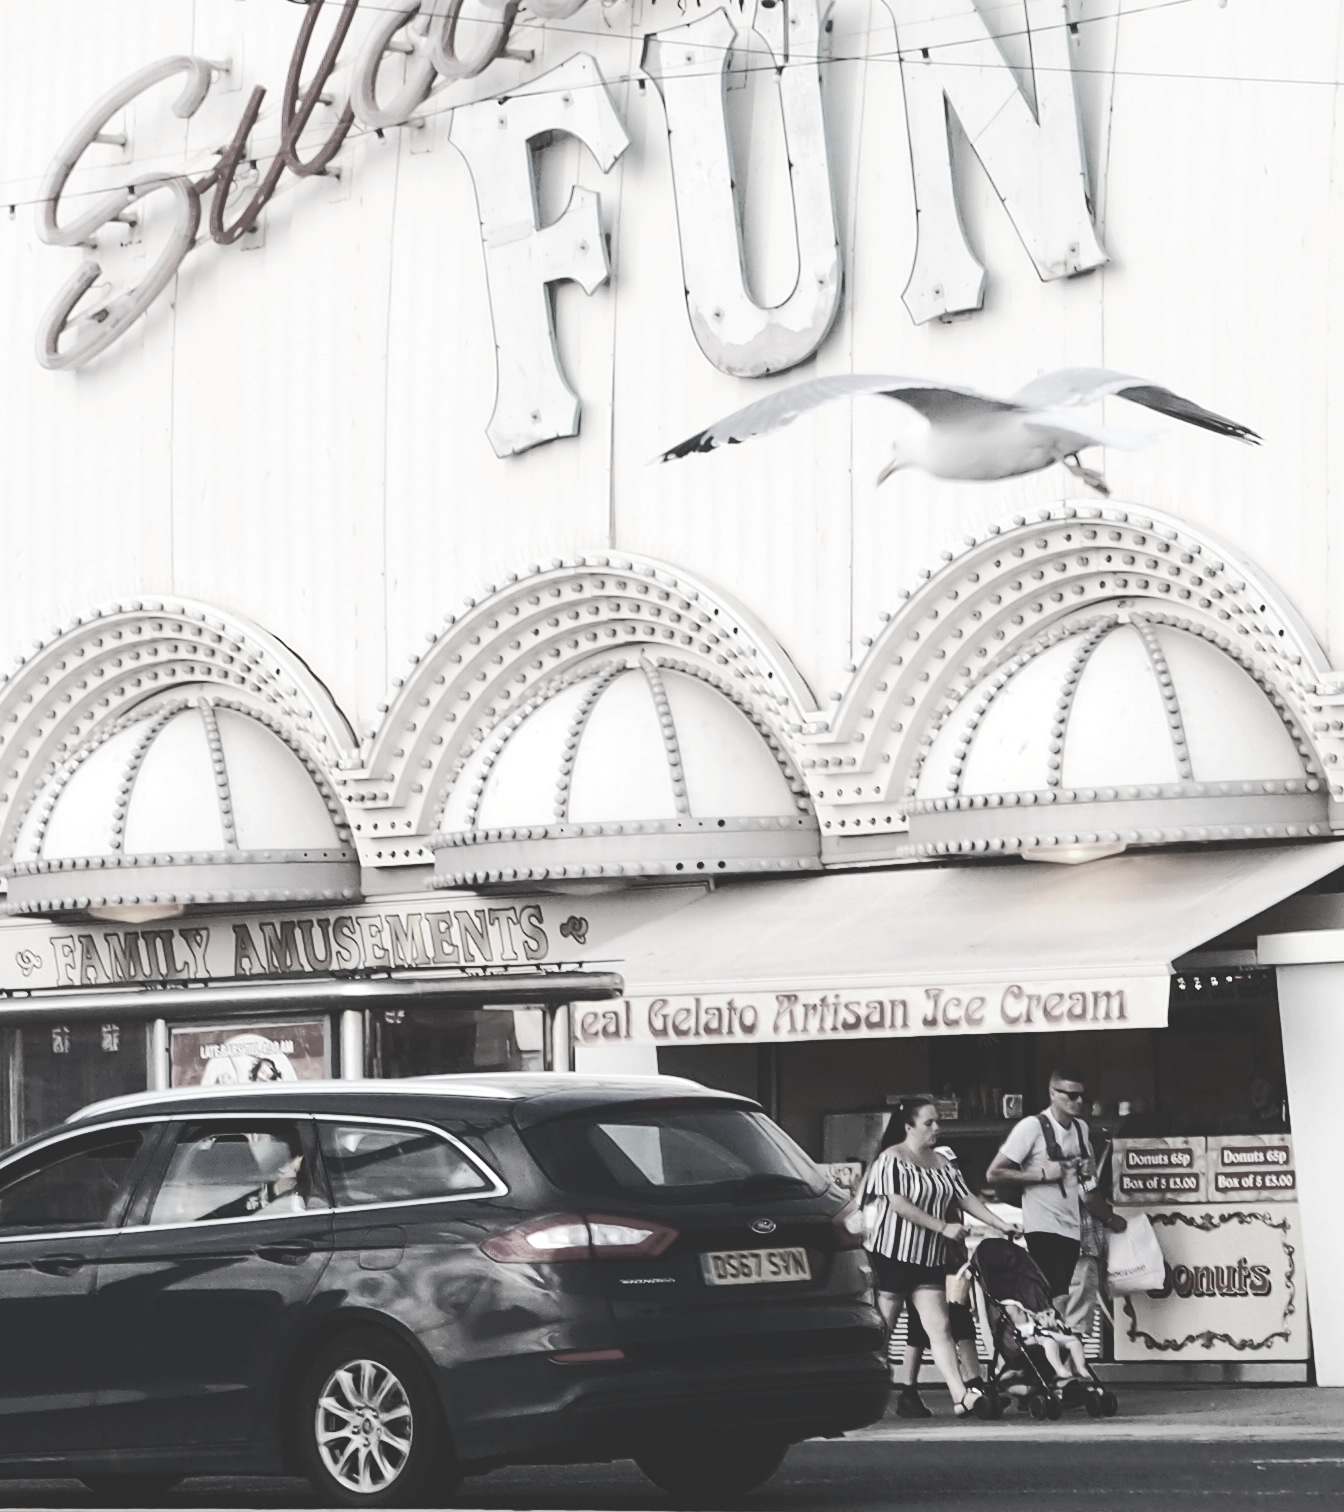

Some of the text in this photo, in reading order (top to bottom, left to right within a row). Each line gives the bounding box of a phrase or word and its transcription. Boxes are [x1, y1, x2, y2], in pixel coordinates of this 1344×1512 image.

[50, 904, 550, 986] FAMILY AMUSEMENTS
[573, 984, 1129, 1042] eal Gelato Artisan Ice Cream
[1128, 1151, 1191, 1167] Donuts 65p
[1223, 1149, 1287, 1164] Donuts 65p
[1122, 1177, 1144, 1190] Box
[1146, 1176, 1158, 1189] of
[1217, 1175, 1239, 1188] Box
[1241, 1174, 1254, 1187] of
[711, 1253, 763, 1279] DS67
